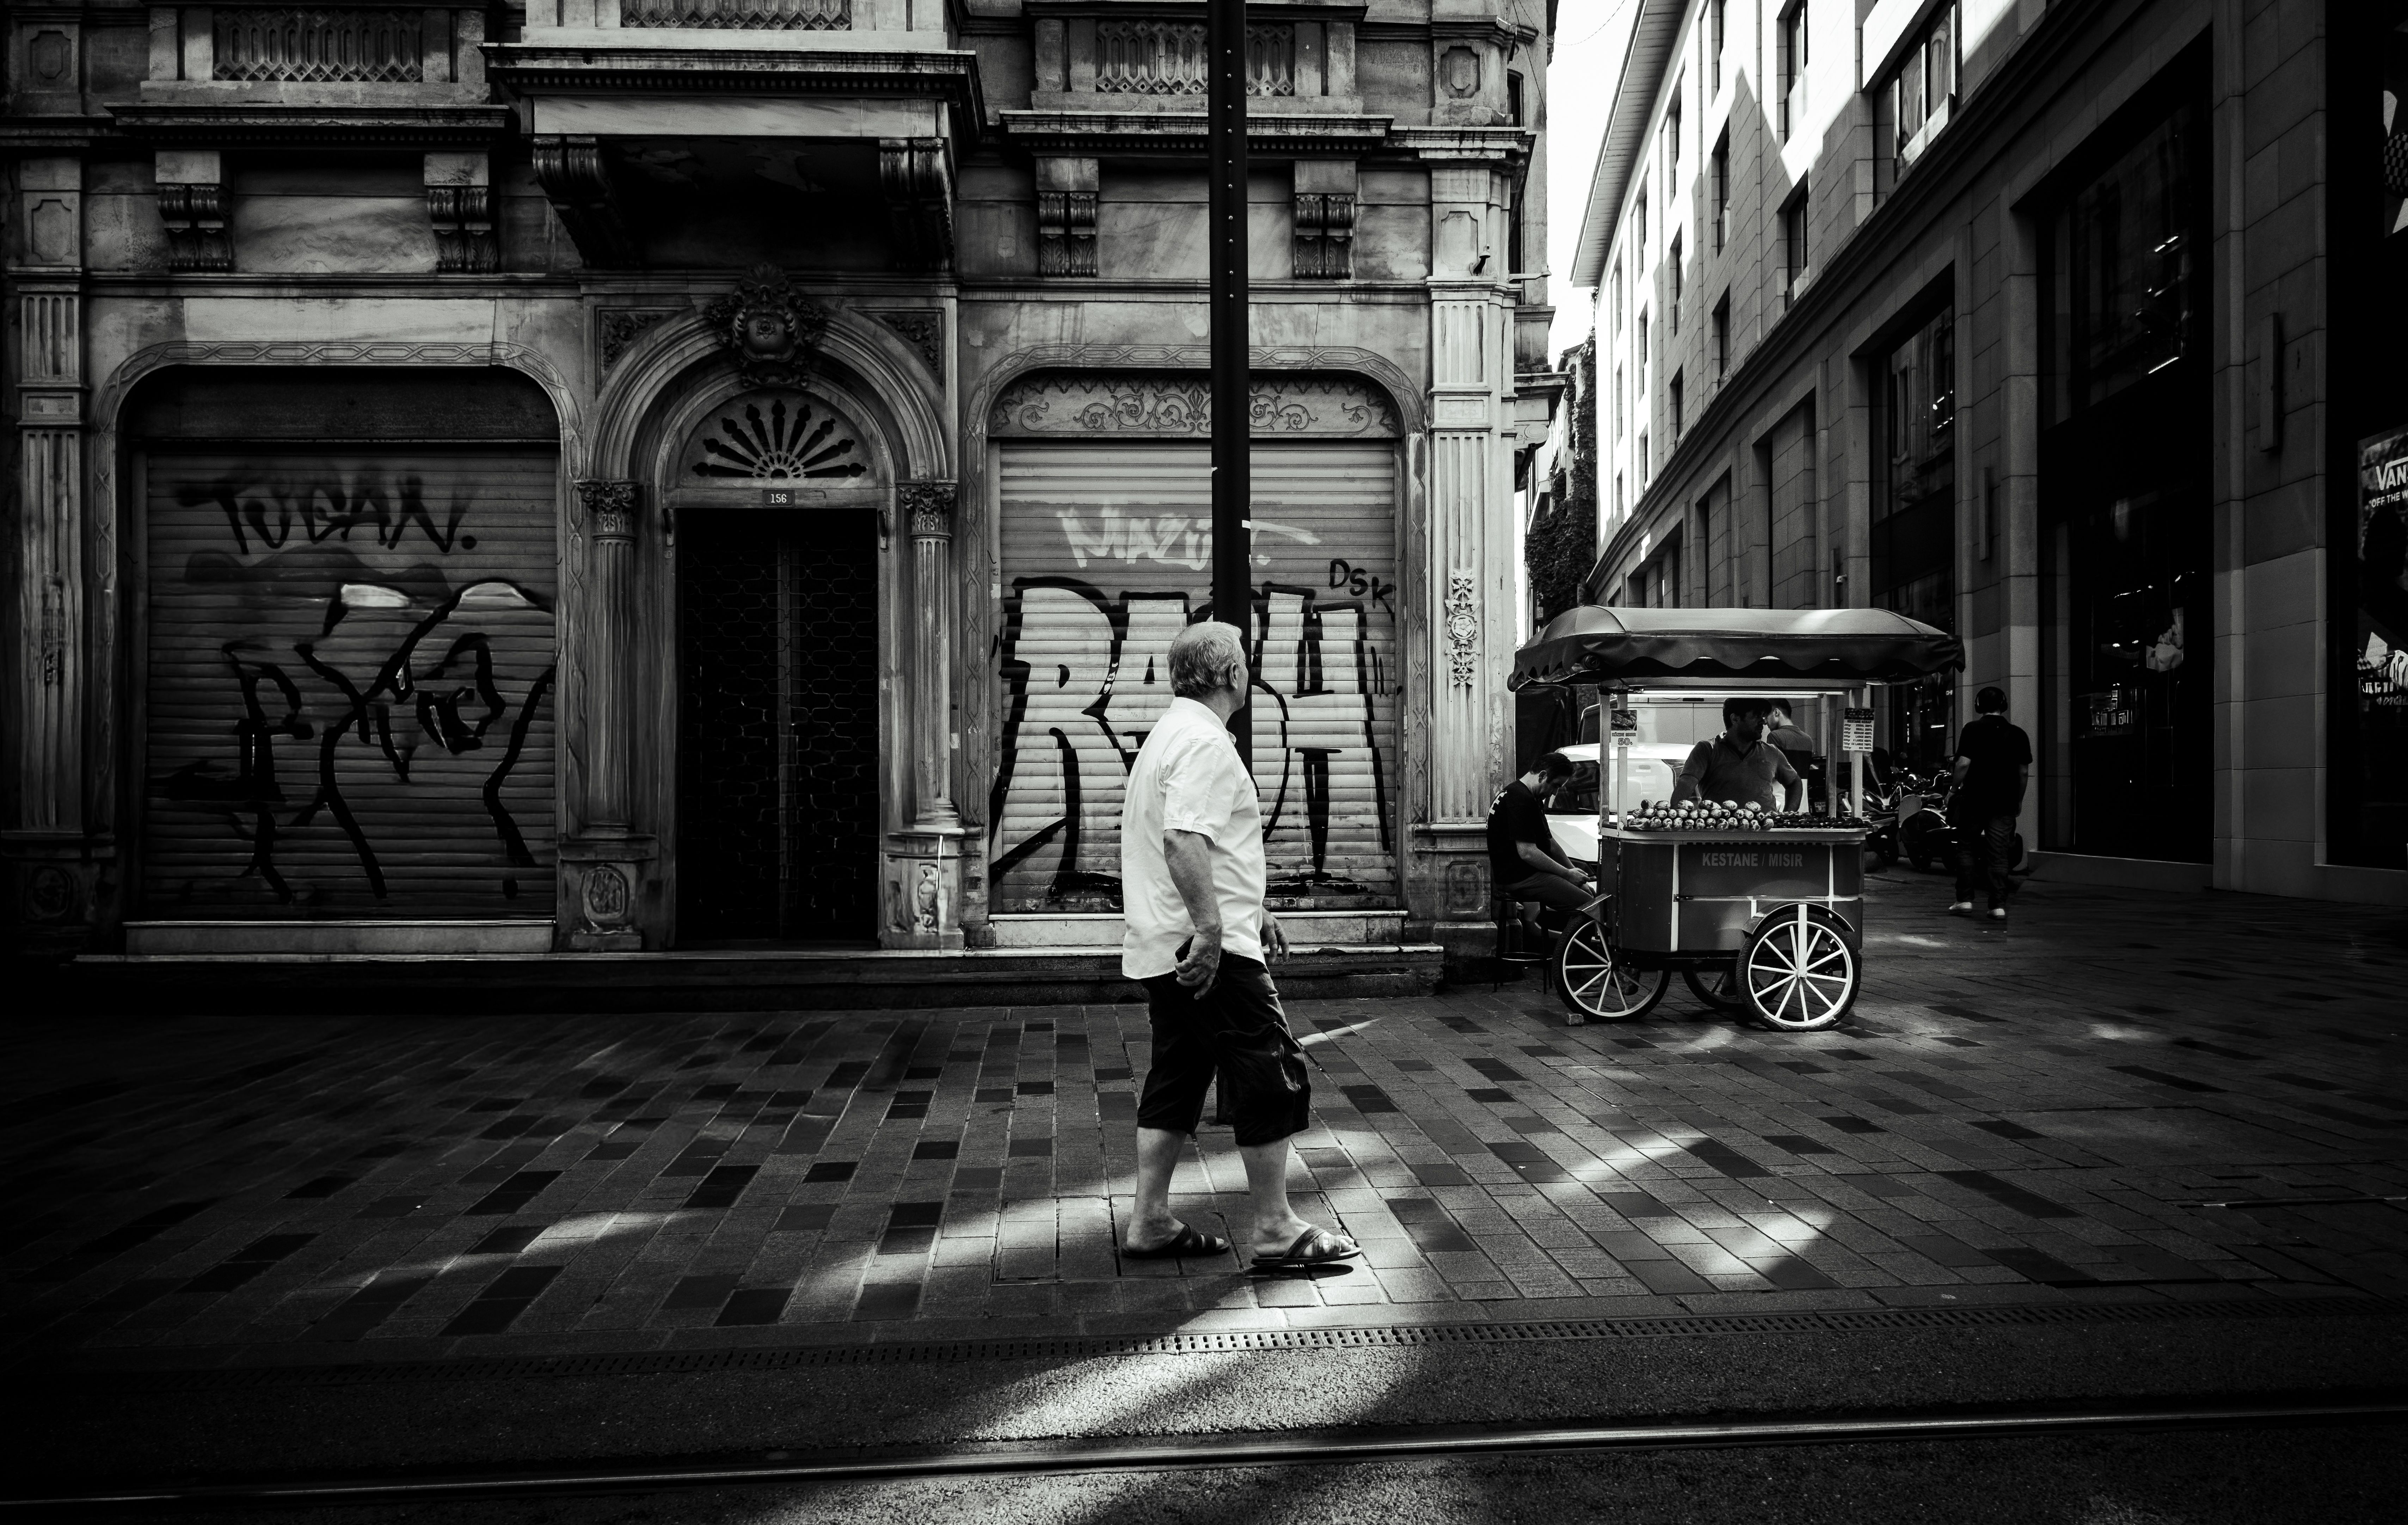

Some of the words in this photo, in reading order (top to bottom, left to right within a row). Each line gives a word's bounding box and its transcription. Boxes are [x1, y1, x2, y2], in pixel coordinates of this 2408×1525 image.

[2376, 456, 2408, 490] VAN
[771, 494, 787, 503] 156
[2387, 492, 2400, 503] THE
[1702, 853, 1758, 866] KESTANE
[1769, 853, 1803, 866] MISIR
